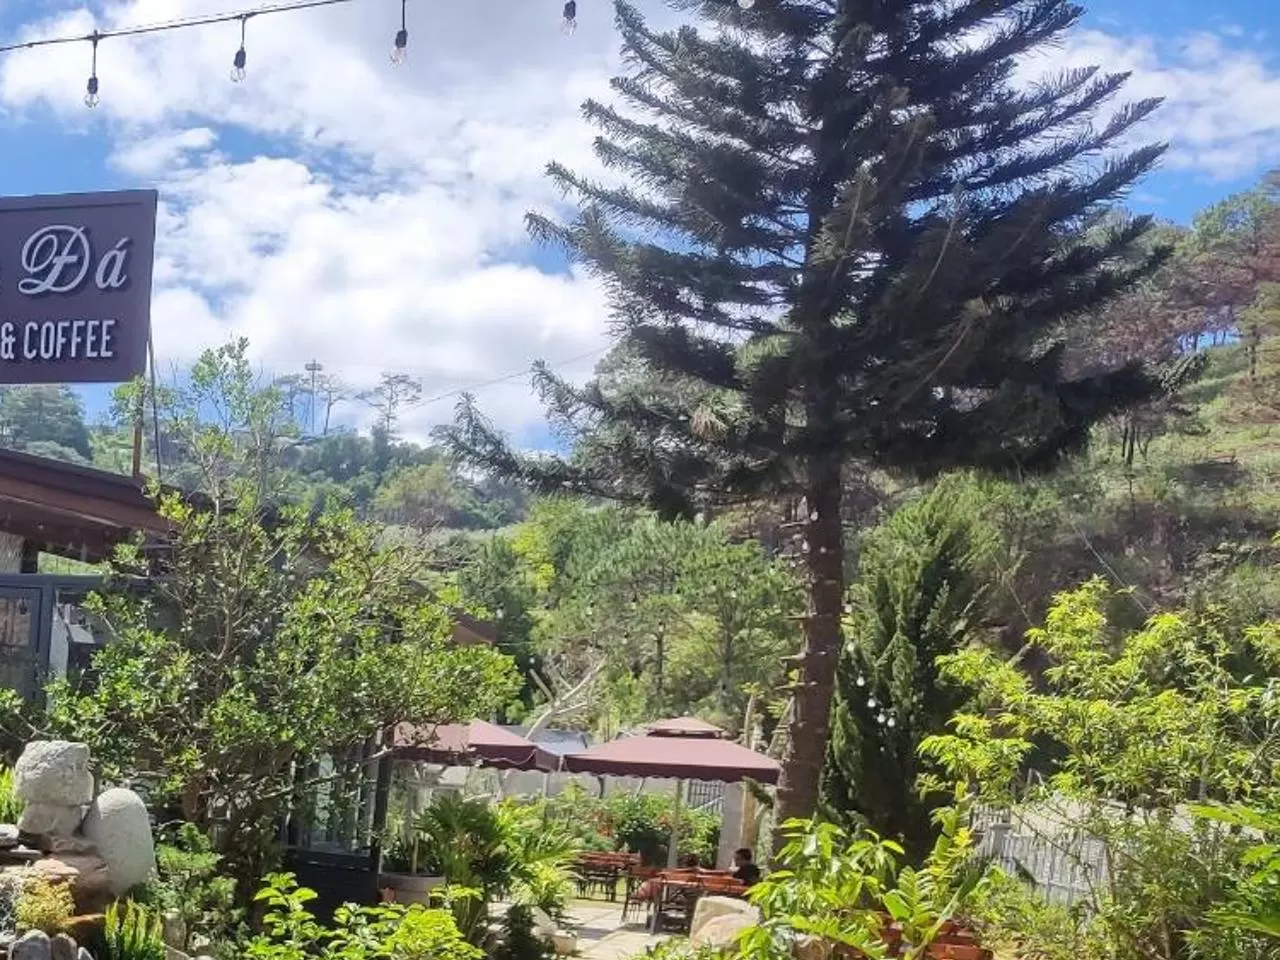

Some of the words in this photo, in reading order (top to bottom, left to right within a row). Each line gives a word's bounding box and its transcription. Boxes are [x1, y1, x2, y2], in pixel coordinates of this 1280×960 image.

[19, 224, 131, 295] Đá
[0, 322, 16, 360] &
[23, 319, 115, 360] COFFEE
